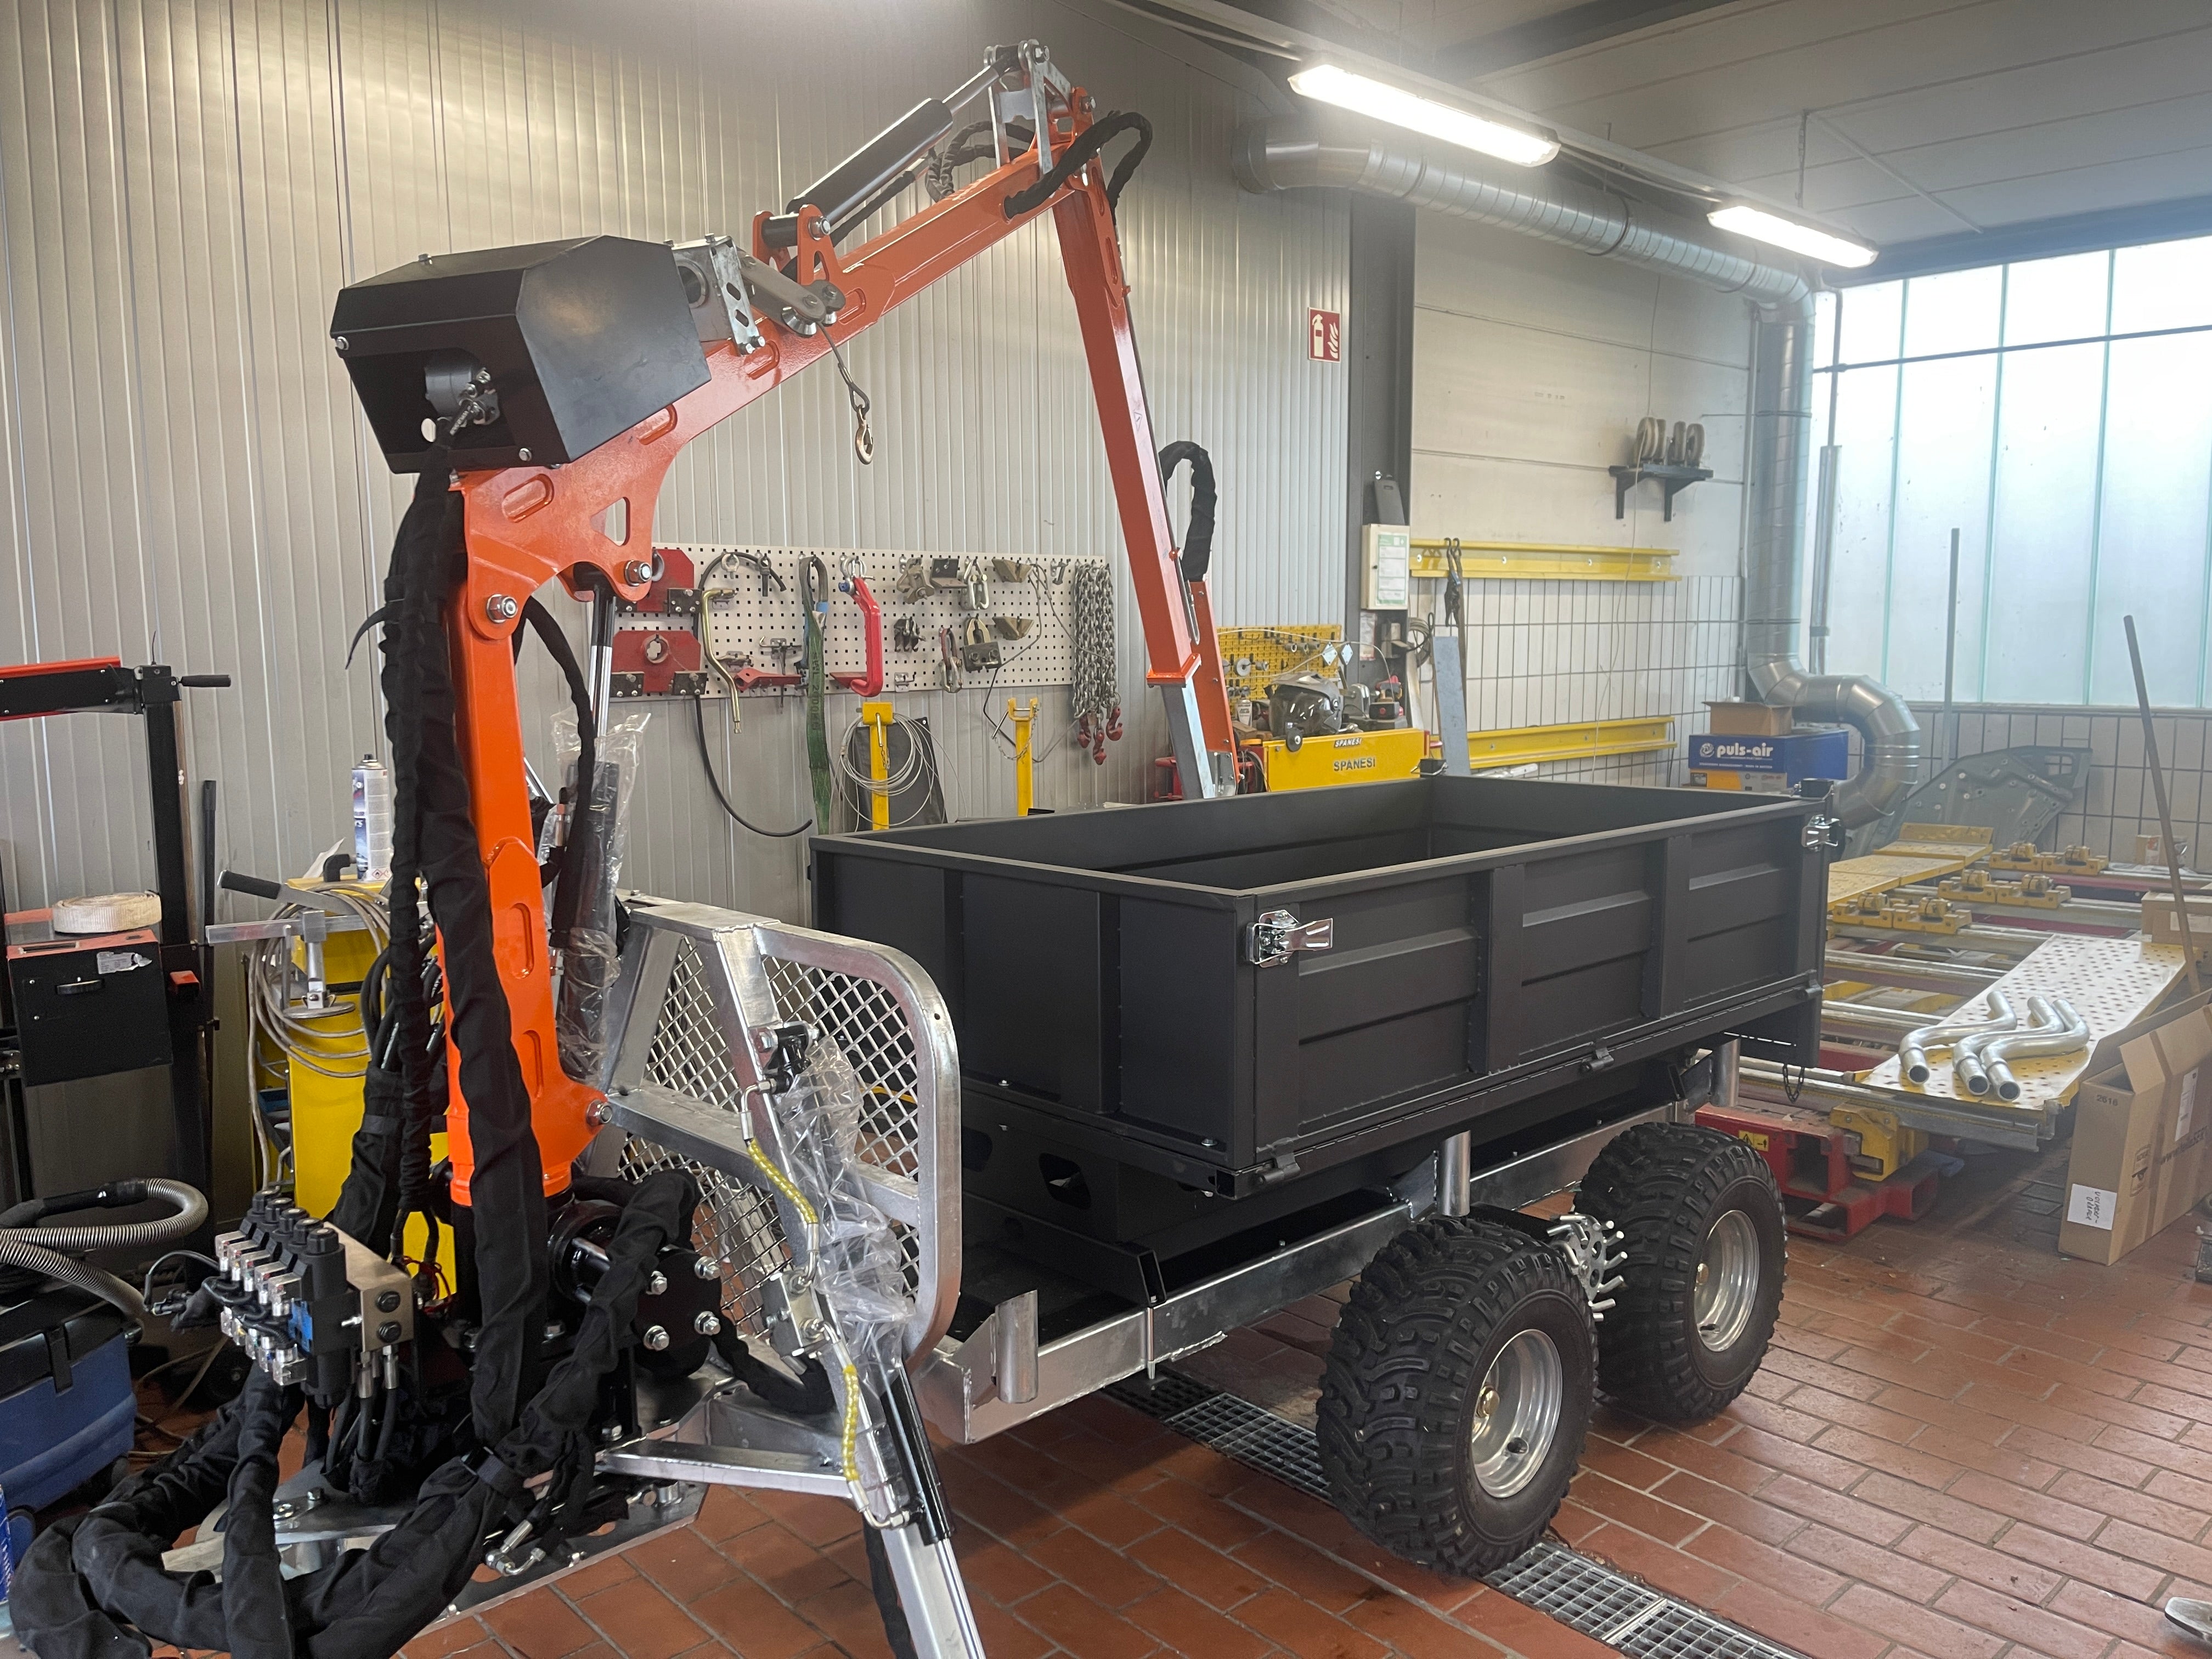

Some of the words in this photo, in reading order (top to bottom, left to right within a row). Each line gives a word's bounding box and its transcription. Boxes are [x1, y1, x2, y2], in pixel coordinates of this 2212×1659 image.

[1335, 737, 1362, 747] SPANESI
[1717, 742, 1773, 758] puls-air
[1334, 757, 1375, 771] SPANESI
